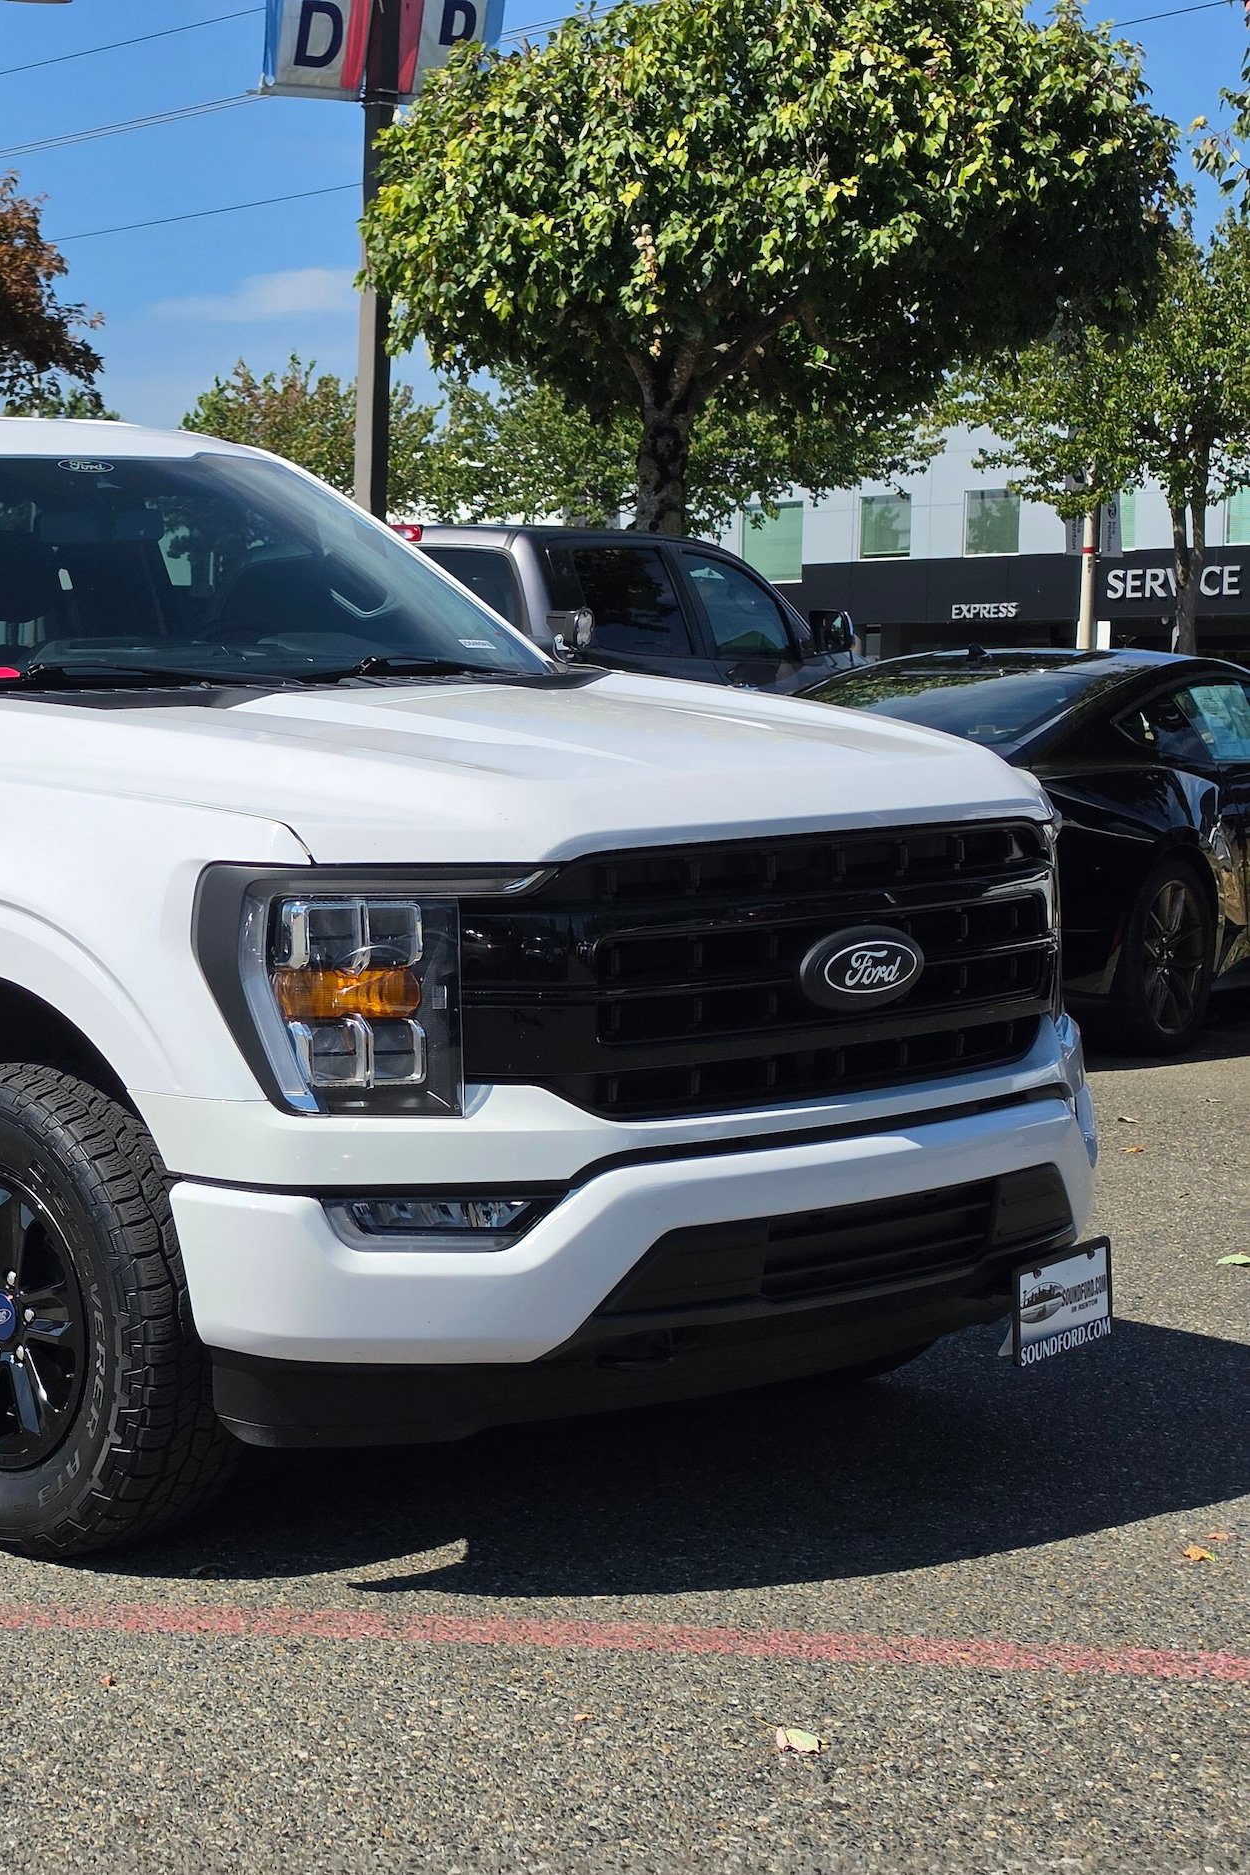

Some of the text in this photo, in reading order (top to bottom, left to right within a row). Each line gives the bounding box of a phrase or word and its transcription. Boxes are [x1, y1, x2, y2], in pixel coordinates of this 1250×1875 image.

[69, 461, 105, 471] Ford
[951, 602, 1019, 619] EXPRESS
[844, 950, 902, 987] Ford
[1020, 1316, 1111, 1367] SOUNDFORD.COM
